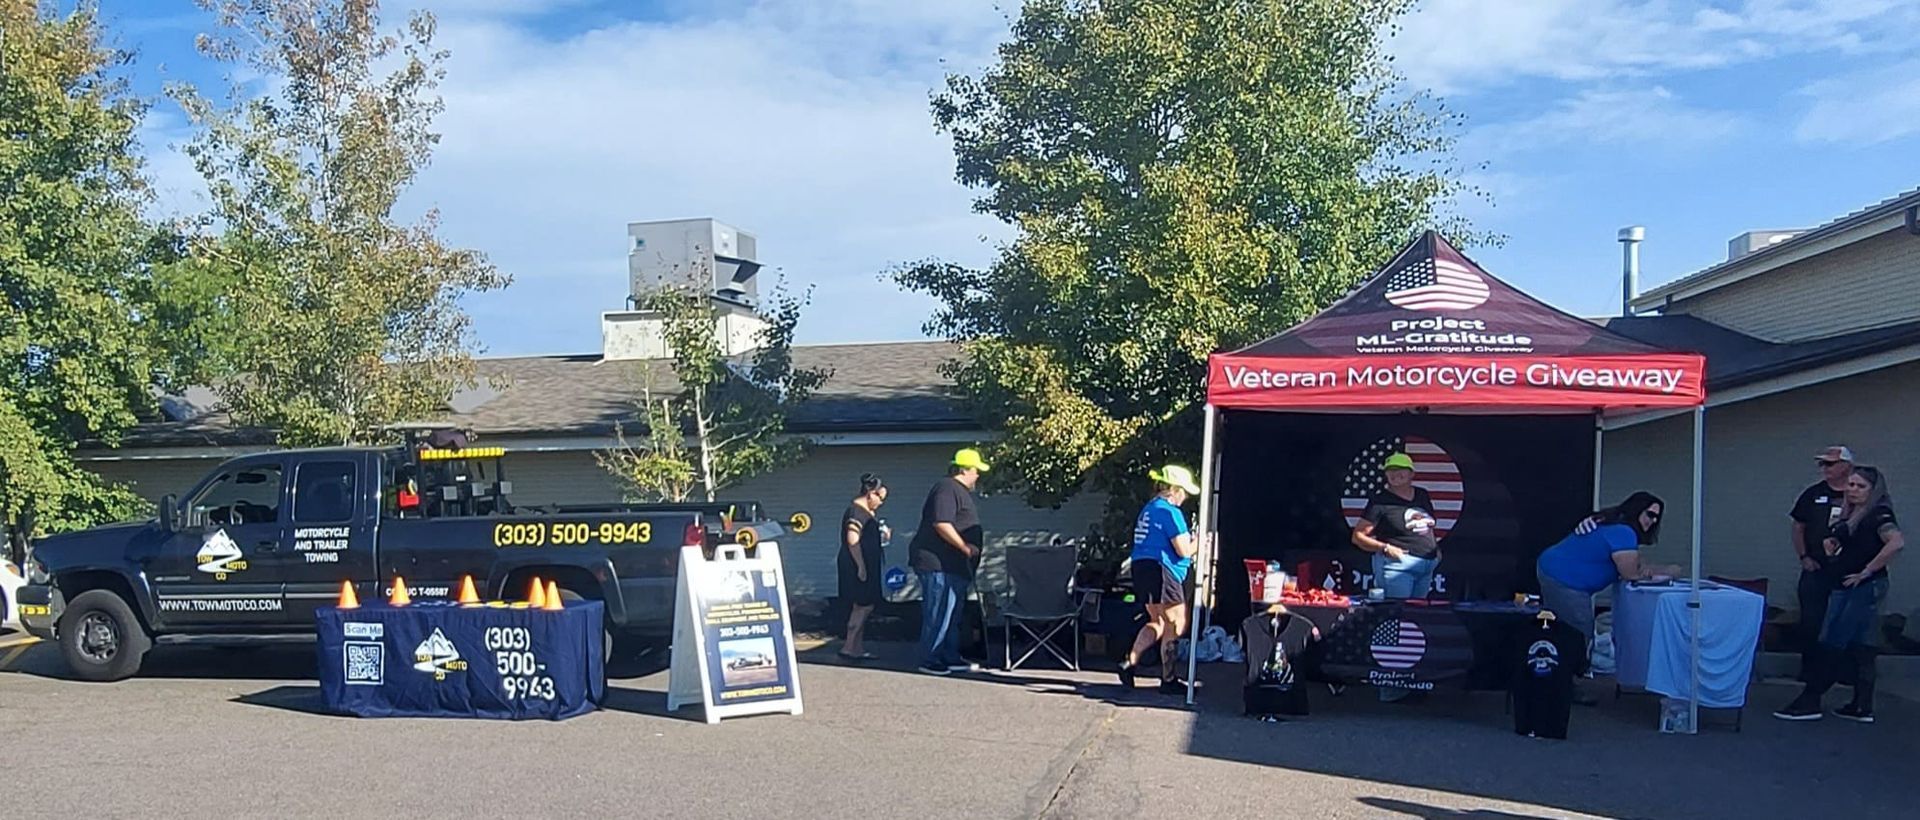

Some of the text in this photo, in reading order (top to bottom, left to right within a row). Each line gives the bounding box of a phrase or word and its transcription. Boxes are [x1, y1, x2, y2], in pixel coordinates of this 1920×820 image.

[1391, 316, 1485, 331] Project
[1356, 331, 1532, 346] ML-Gratitude
[1406, 345, 1472, 353] Motorcycle
[1474, 345, 1534, 353] Giveaway
[1224, 363, 1683, 393] Veteran Motorcycle Giveaway
[294, 527, 350, 538] MOTORCYCLE
[494, 522, 651, 547] (303) 500-9943
[294, 539, 348, 551] AND TRAILER
[197, 554, 214, 563] TOW
[304, 552, 338, 562] TOWING
[226, 560, 247, 570] MOTO
[215, 572, 227, 581] CO
[159, 600, 282, 611] WWW.TOWMOTOCO.COM
[346, 625, 383, 634] Scan Me
[485, 627, 531, 651] (303)
[445, 660, 468, 670] MOTO
[496, 651, 546, 675] 500-
[503, 676, 556, 700] 9943
